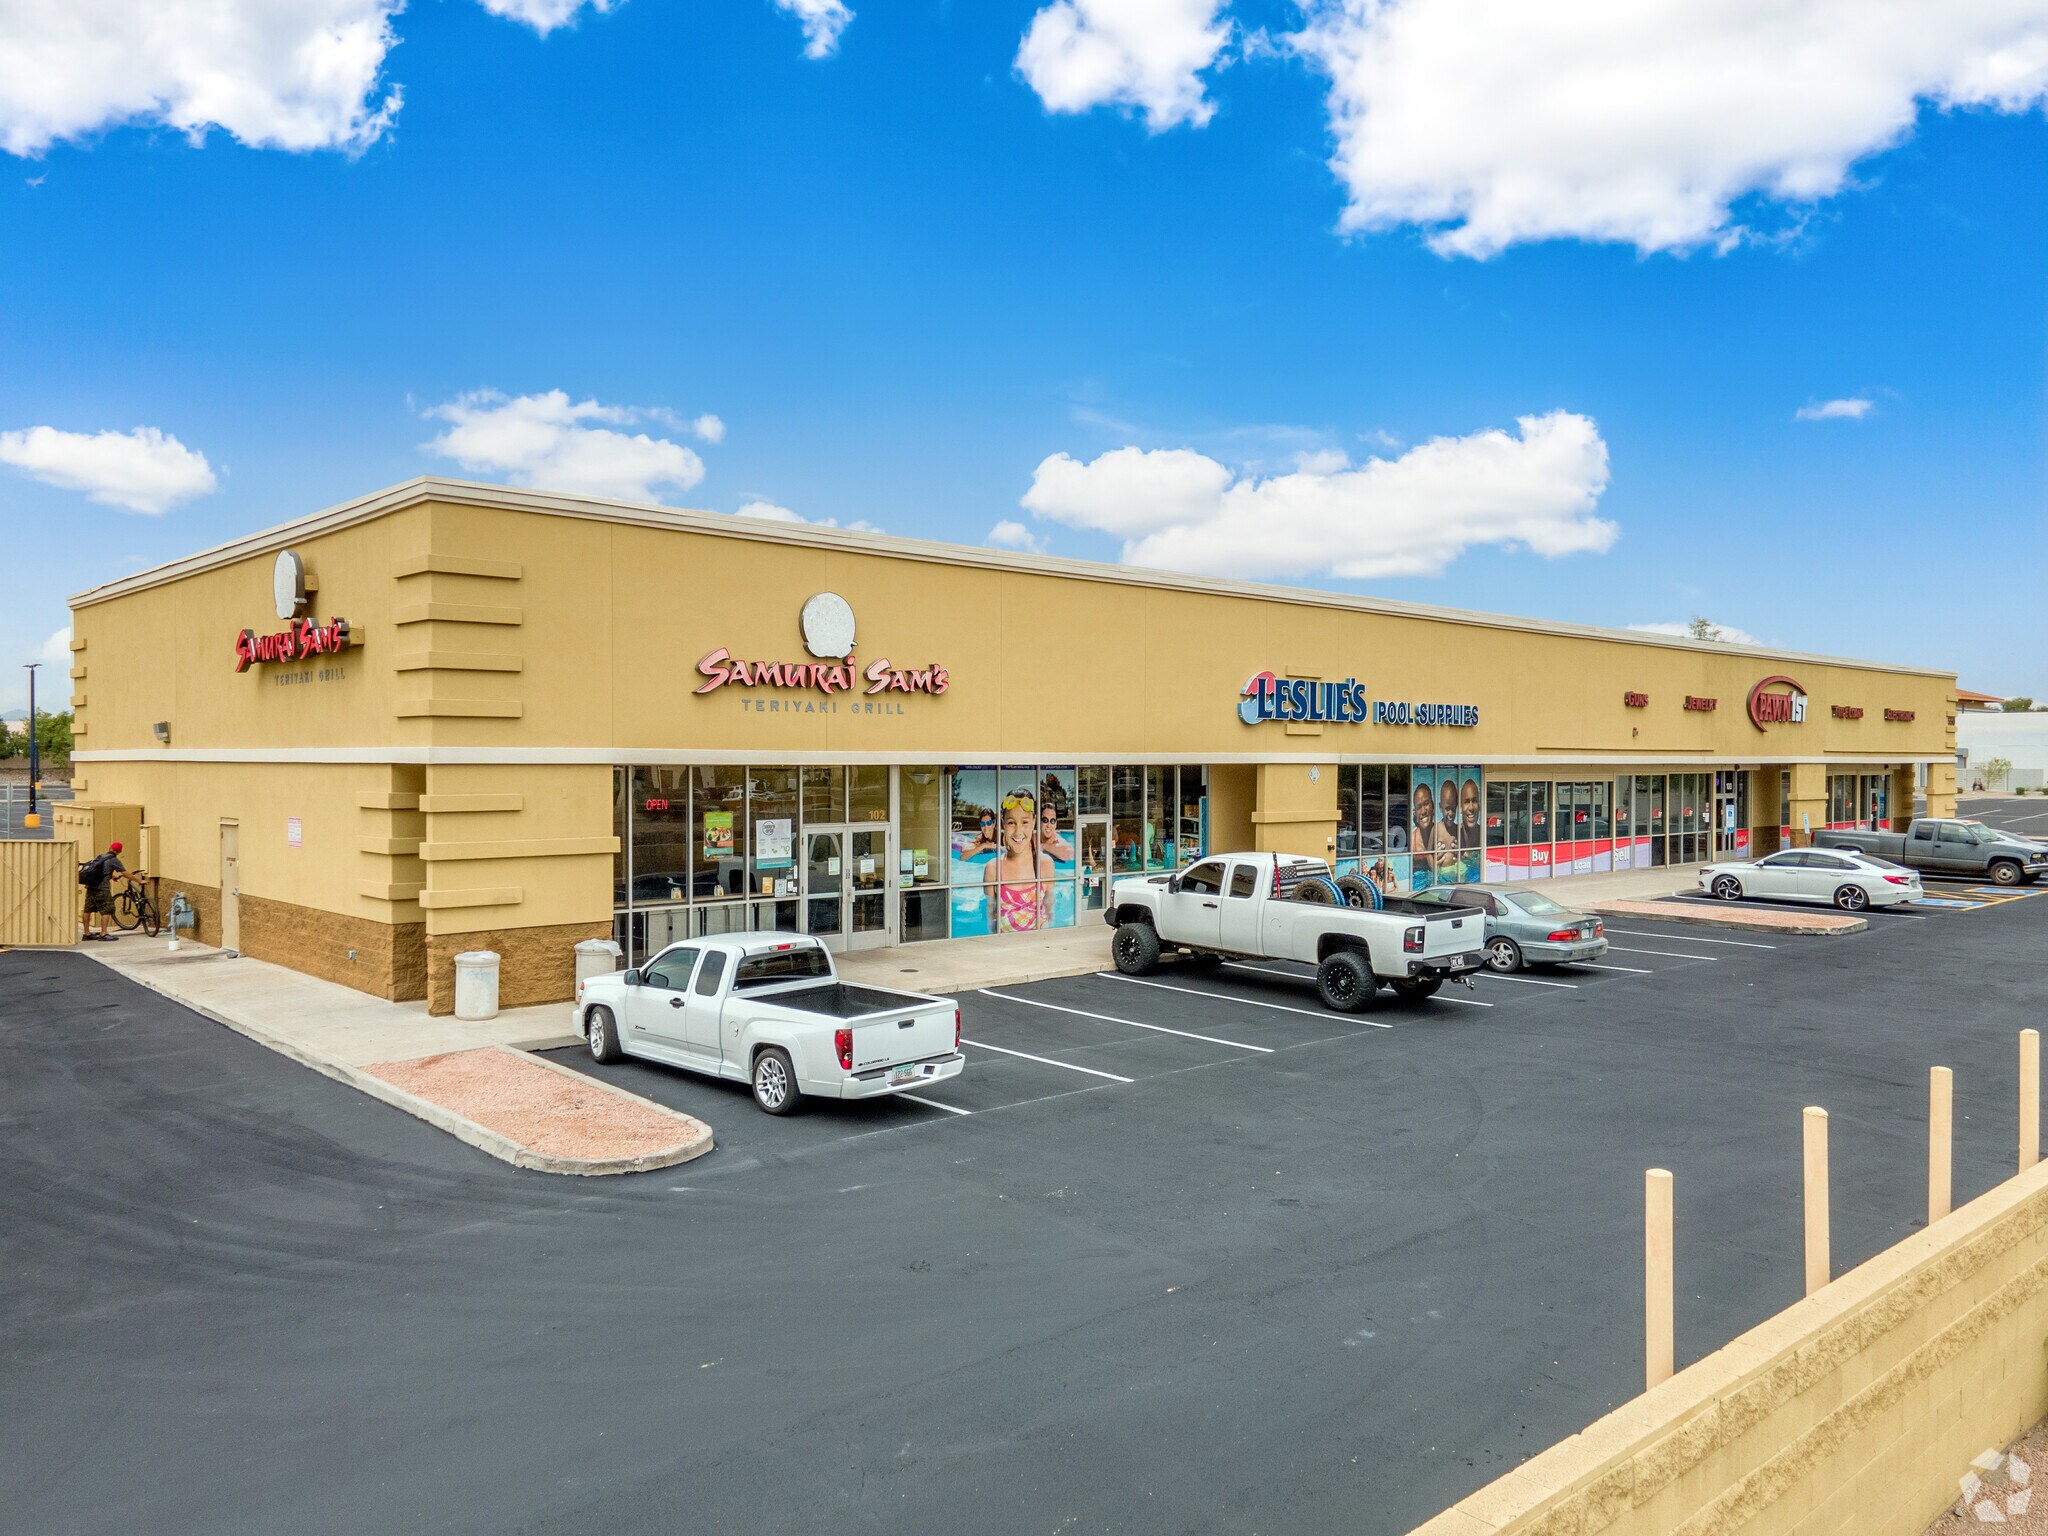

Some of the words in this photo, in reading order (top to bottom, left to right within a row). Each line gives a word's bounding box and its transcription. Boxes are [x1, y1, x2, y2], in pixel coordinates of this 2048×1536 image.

[274, 671, 314, 686] TERIYAKI
[318, 667, 346, 682] GRILL
[741, 698, 838, 714] TERIYAKI
[851, 702, 905, 715] GRILL
[1256, 678, 1368, 724] LESLIE'S
[1374, 701, 1414, 725] POOL
[1415, 702, 1480, 727] SUPPLIES
[1627, 691, 1649, 708] GUNS
[1758, 693, 1791, 722] PAWN
[645, 799, 669, 811] OPEN
[869, 810, 885, 820] 102
[1531, 849, 1549, 864] Buy
[1614, 847, 1630, 862] Sell
[1574, 860, 1591, 870] Loan
